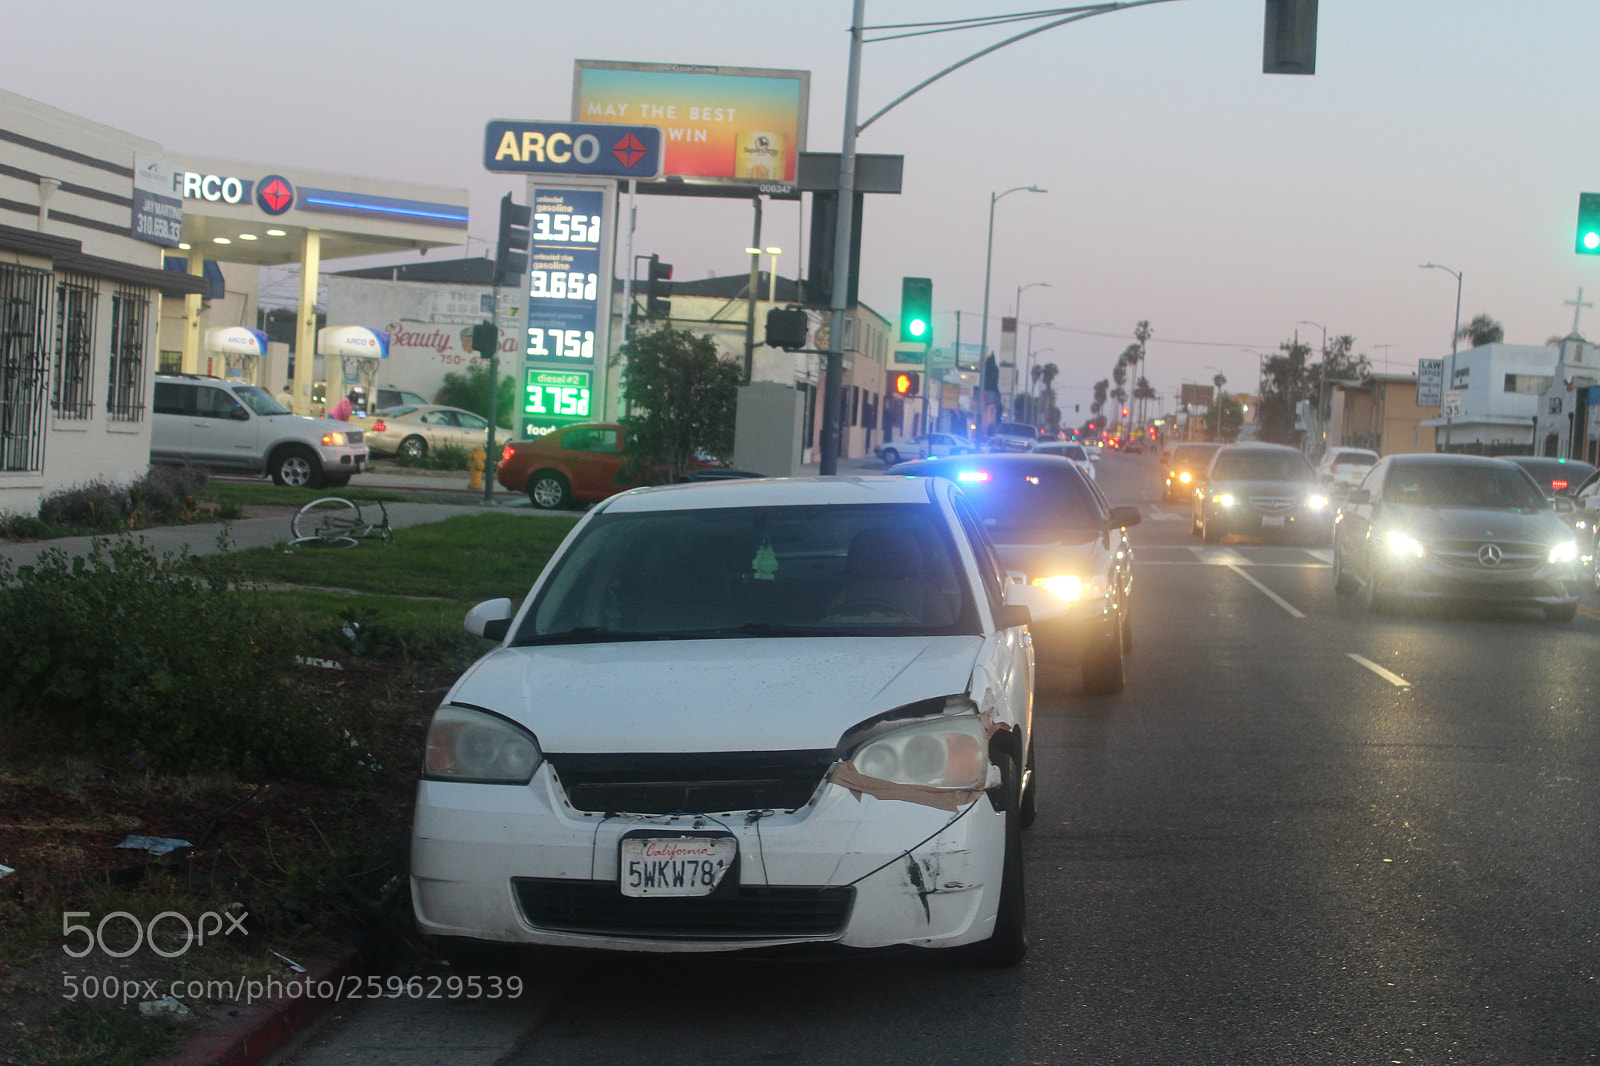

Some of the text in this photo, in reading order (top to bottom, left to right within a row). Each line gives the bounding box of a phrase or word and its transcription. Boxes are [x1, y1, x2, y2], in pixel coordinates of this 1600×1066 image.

[587, 102, 736, 122] MAY THE BEST
[668, 128, 708, 143] WIN
[494, 131, 600, 164] ARCO
[183, 171, 243, 204] RCO
[536, 204, 574, 212] gasoline
[532, 261, 570, 270] gasoline
[385, 322, 453, 353] Beauty
[1421, 360, 1441, 370] LAW
[537, 374, 566, 384] diesel
[1446, 405, 1460, 417] 35
[646, 843, 716, 860] California
